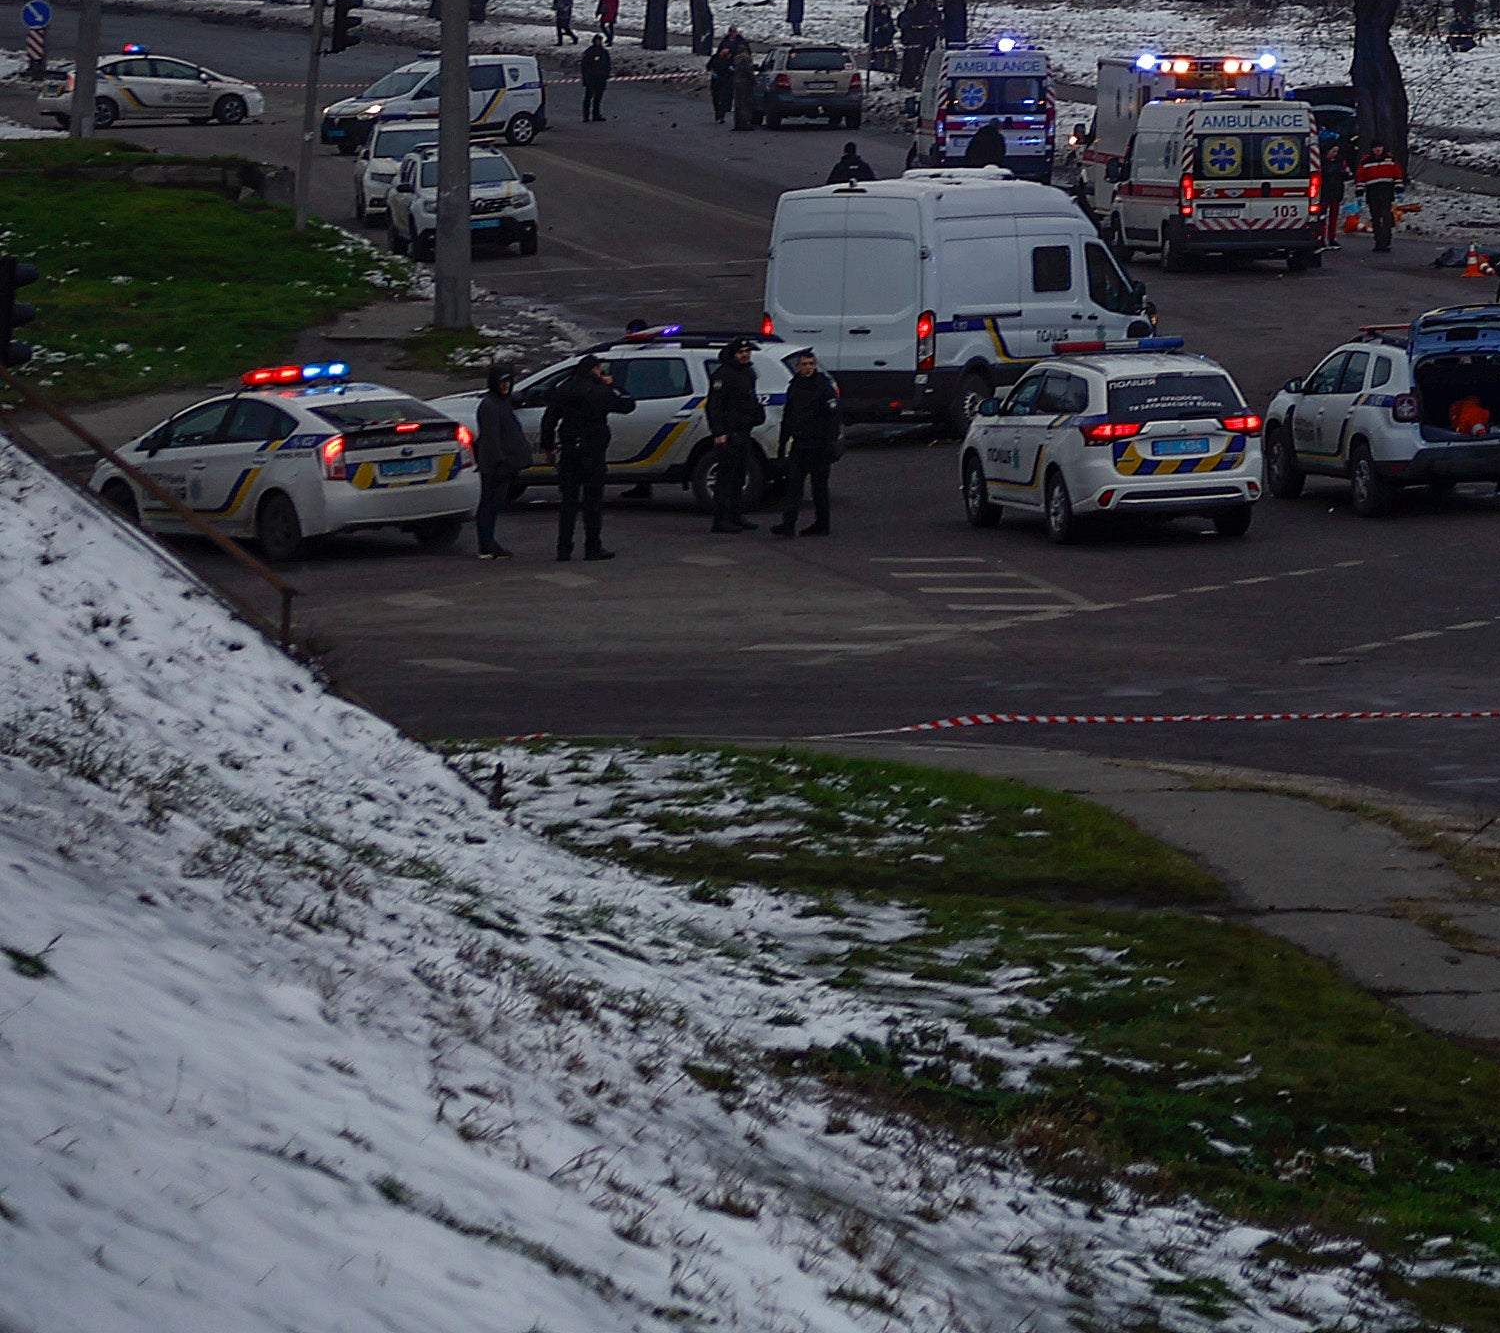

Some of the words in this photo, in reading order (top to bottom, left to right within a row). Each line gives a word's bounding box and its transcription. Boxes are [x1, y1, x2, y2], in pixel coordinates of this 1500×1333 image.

[954, 60, 1041, 72] AMBULANCE
[1201, 115, 1304, 128] AMBULANCE
[1272, 205, 1299, 218] 103
